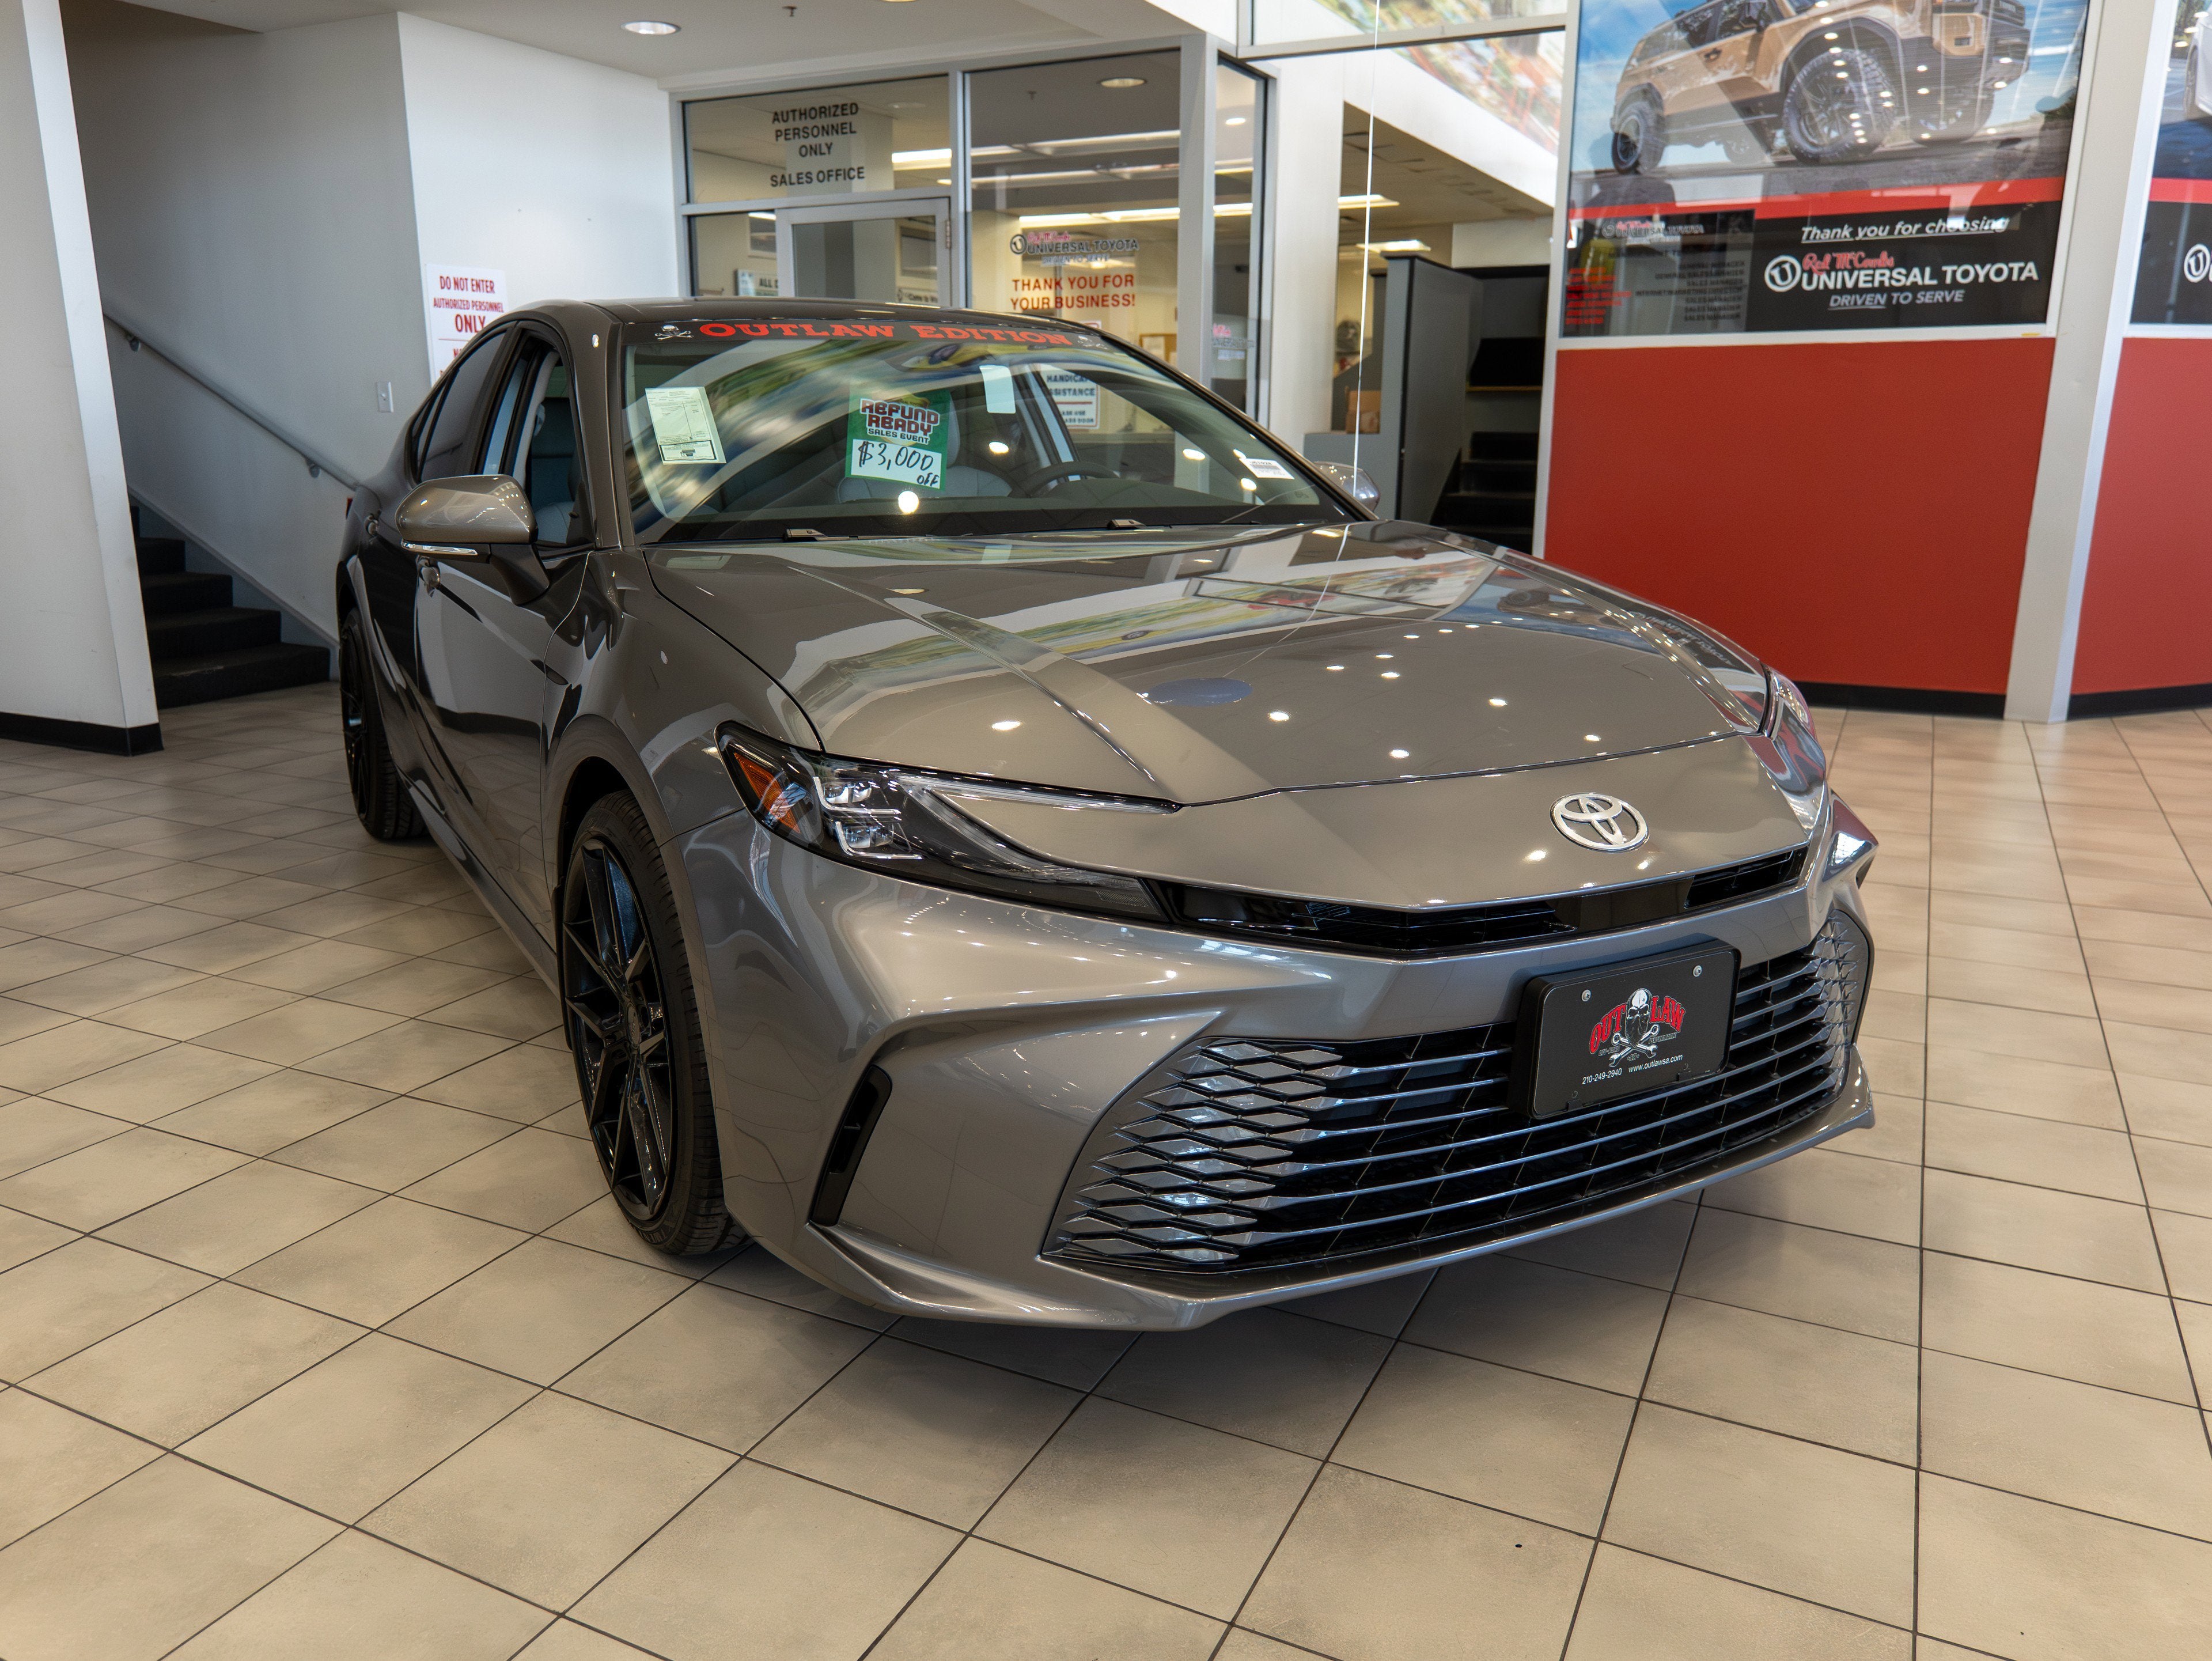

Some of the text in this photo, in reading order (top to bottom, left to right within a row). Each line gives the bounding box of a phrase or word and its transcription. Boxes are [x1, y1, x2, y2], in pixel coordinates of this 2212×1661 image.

[772, 103, 859, 124] AUTHORIZED
[775, 122, 857, 141] PERSONNEL
[798, 142, 833, 157] ONLY
[770, 166, 865, 187] SALES OFFICE
[1801, 224, 1854, 241] Thank
[1855, 225, 1890, 241] you
[1893, 220, 1922, 236] for
[1027, 239, 1139, 254] UNIVERSAL TOYOTA
[440, 276, 495, 294] DO NOT ENTER
[1012, 274, 1134, 292] THANK YOU FOR
[1801, 261, 2039, 290] UNIVERSAL TOYOTA
[434, 297, 504, 313] AUTHORIZED PERSONNEL
[1010, 294, 1135, 311] YOUR BUSINESS!
[1829, 289, 1965, 307] DRIVEN TO SERVE
[455, 314, 486, 333] ONLY
[699, 323, 1073, 345] OUTLAW EDITION
[861, 399, 940, 425] REFUND
[868, 414, 931, 436] READY
[868, 428, 929, 444] SALES EVENT
[858, 441, 934, 471] $3,000
[1582, 1068, 1623, 1085] 210-249-2940
[1628, 1054, 1683, 1073] www.outlawsa.com
